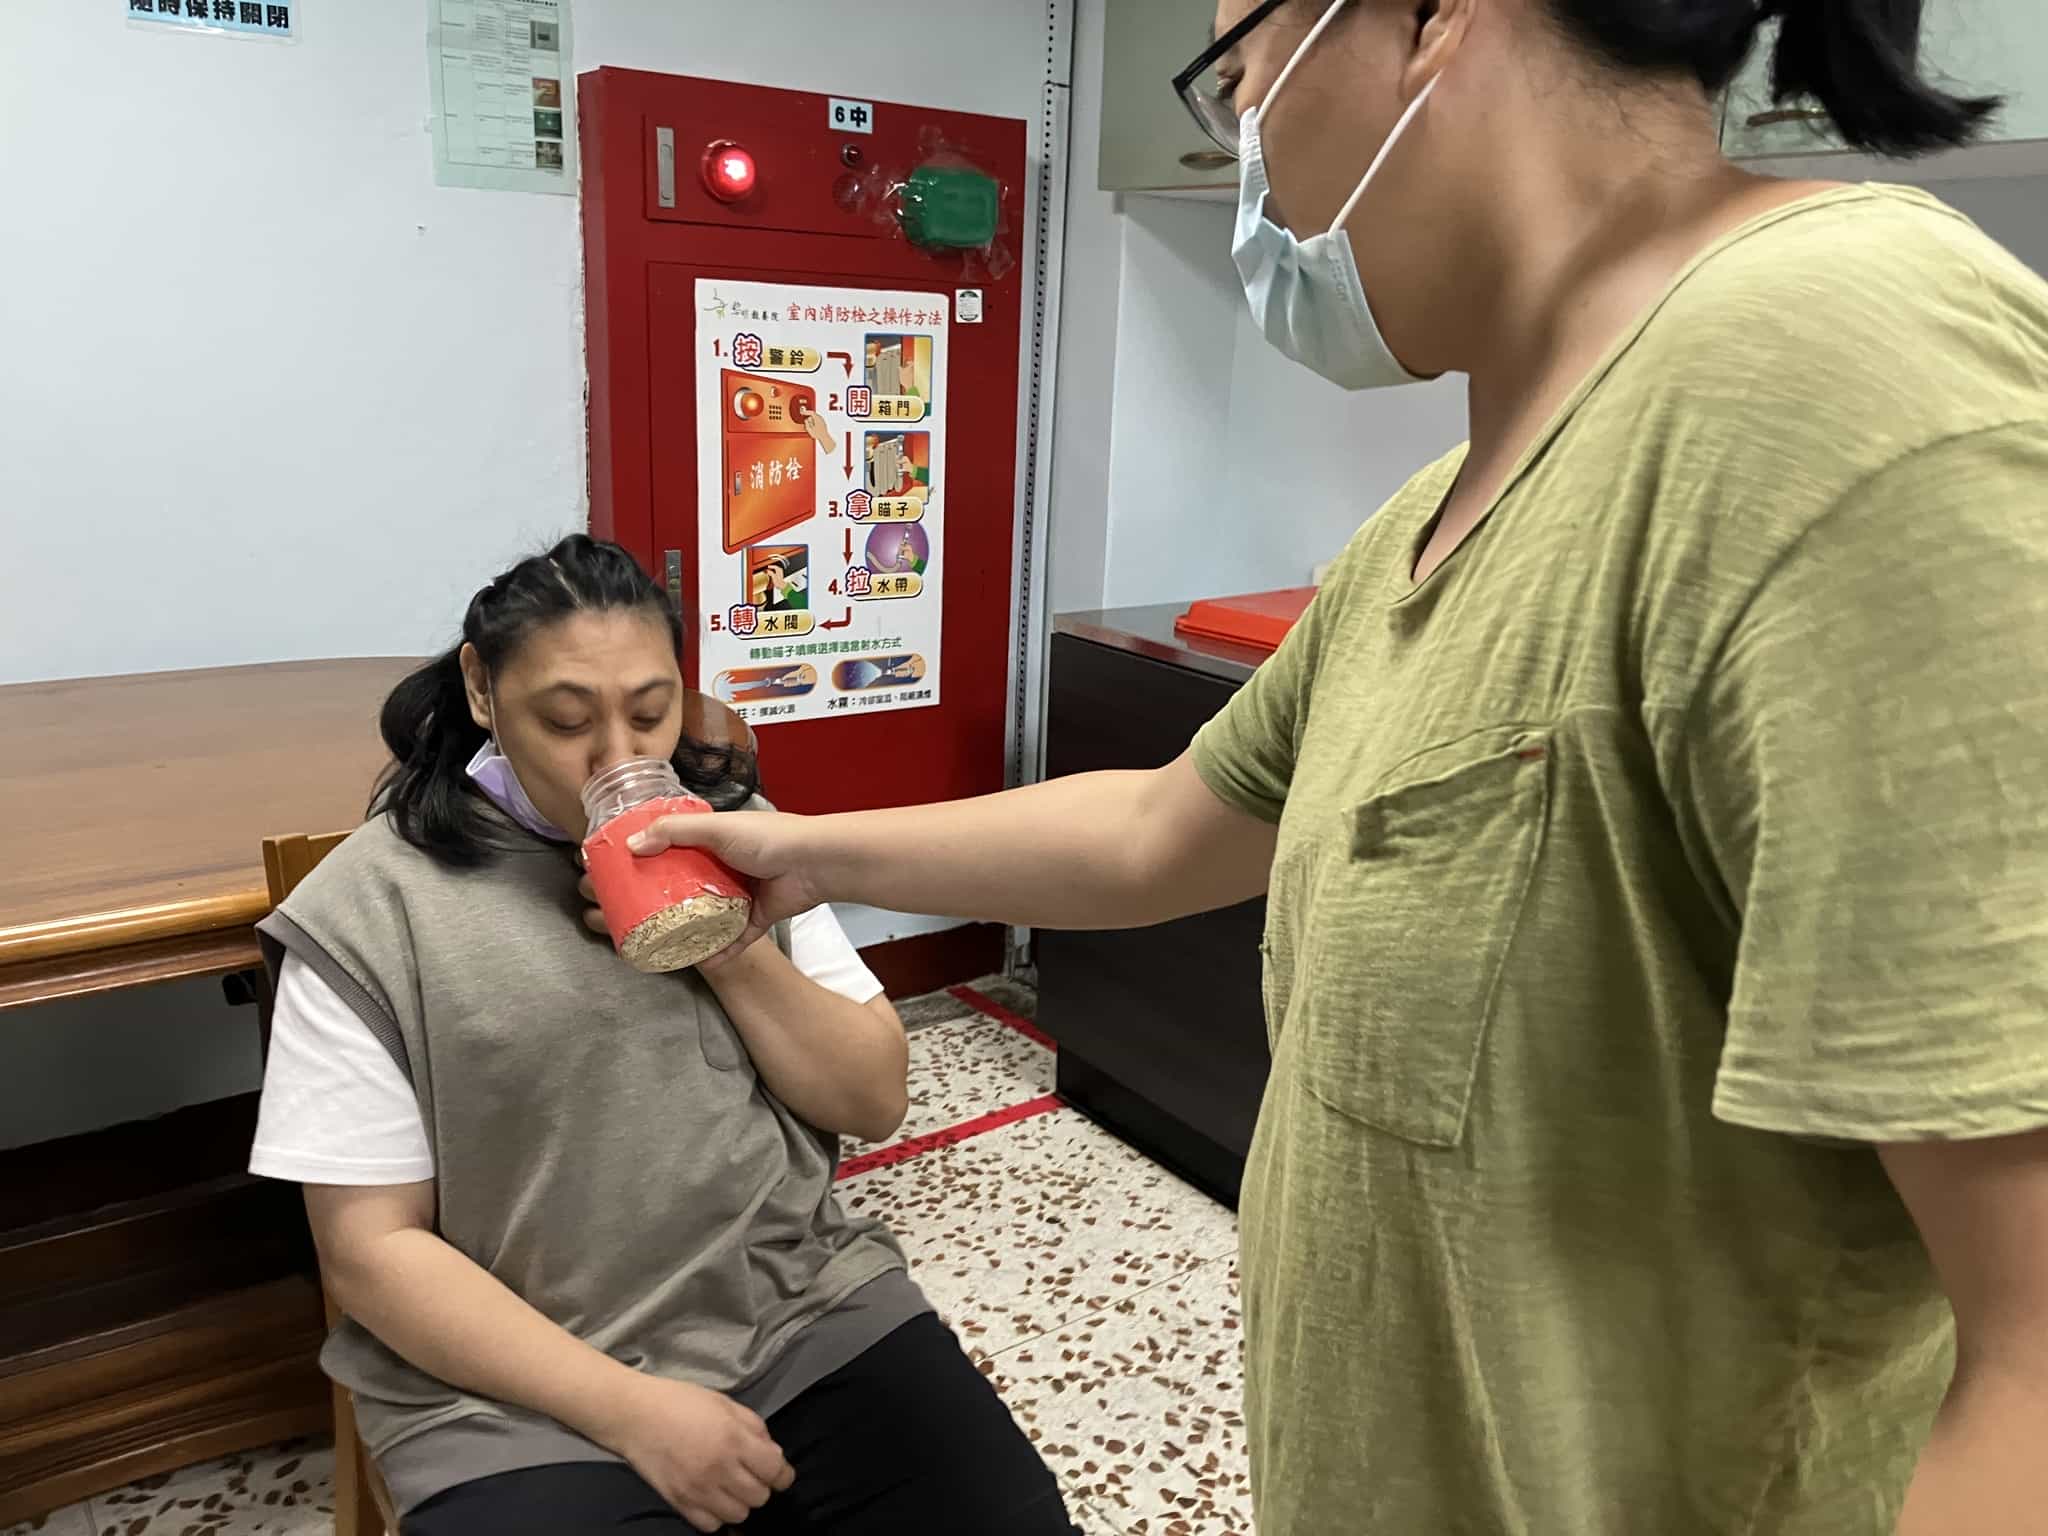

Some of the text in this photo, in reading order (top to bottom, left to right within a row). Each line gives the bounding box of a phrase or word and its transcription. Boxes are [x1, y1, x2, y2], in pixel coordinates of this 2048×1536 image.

[787, 302, 943, 326] 室內消防栓之操作方法
[712, 339, 728, 357] 1.
[829, 393, 843, 411] 2.
[750, 457, 804, 490] 消防栓
[828, 501, 842, 517] 3.
[828, 579, 842, 595] 4.
[711, 615, 726, 631] 5.
